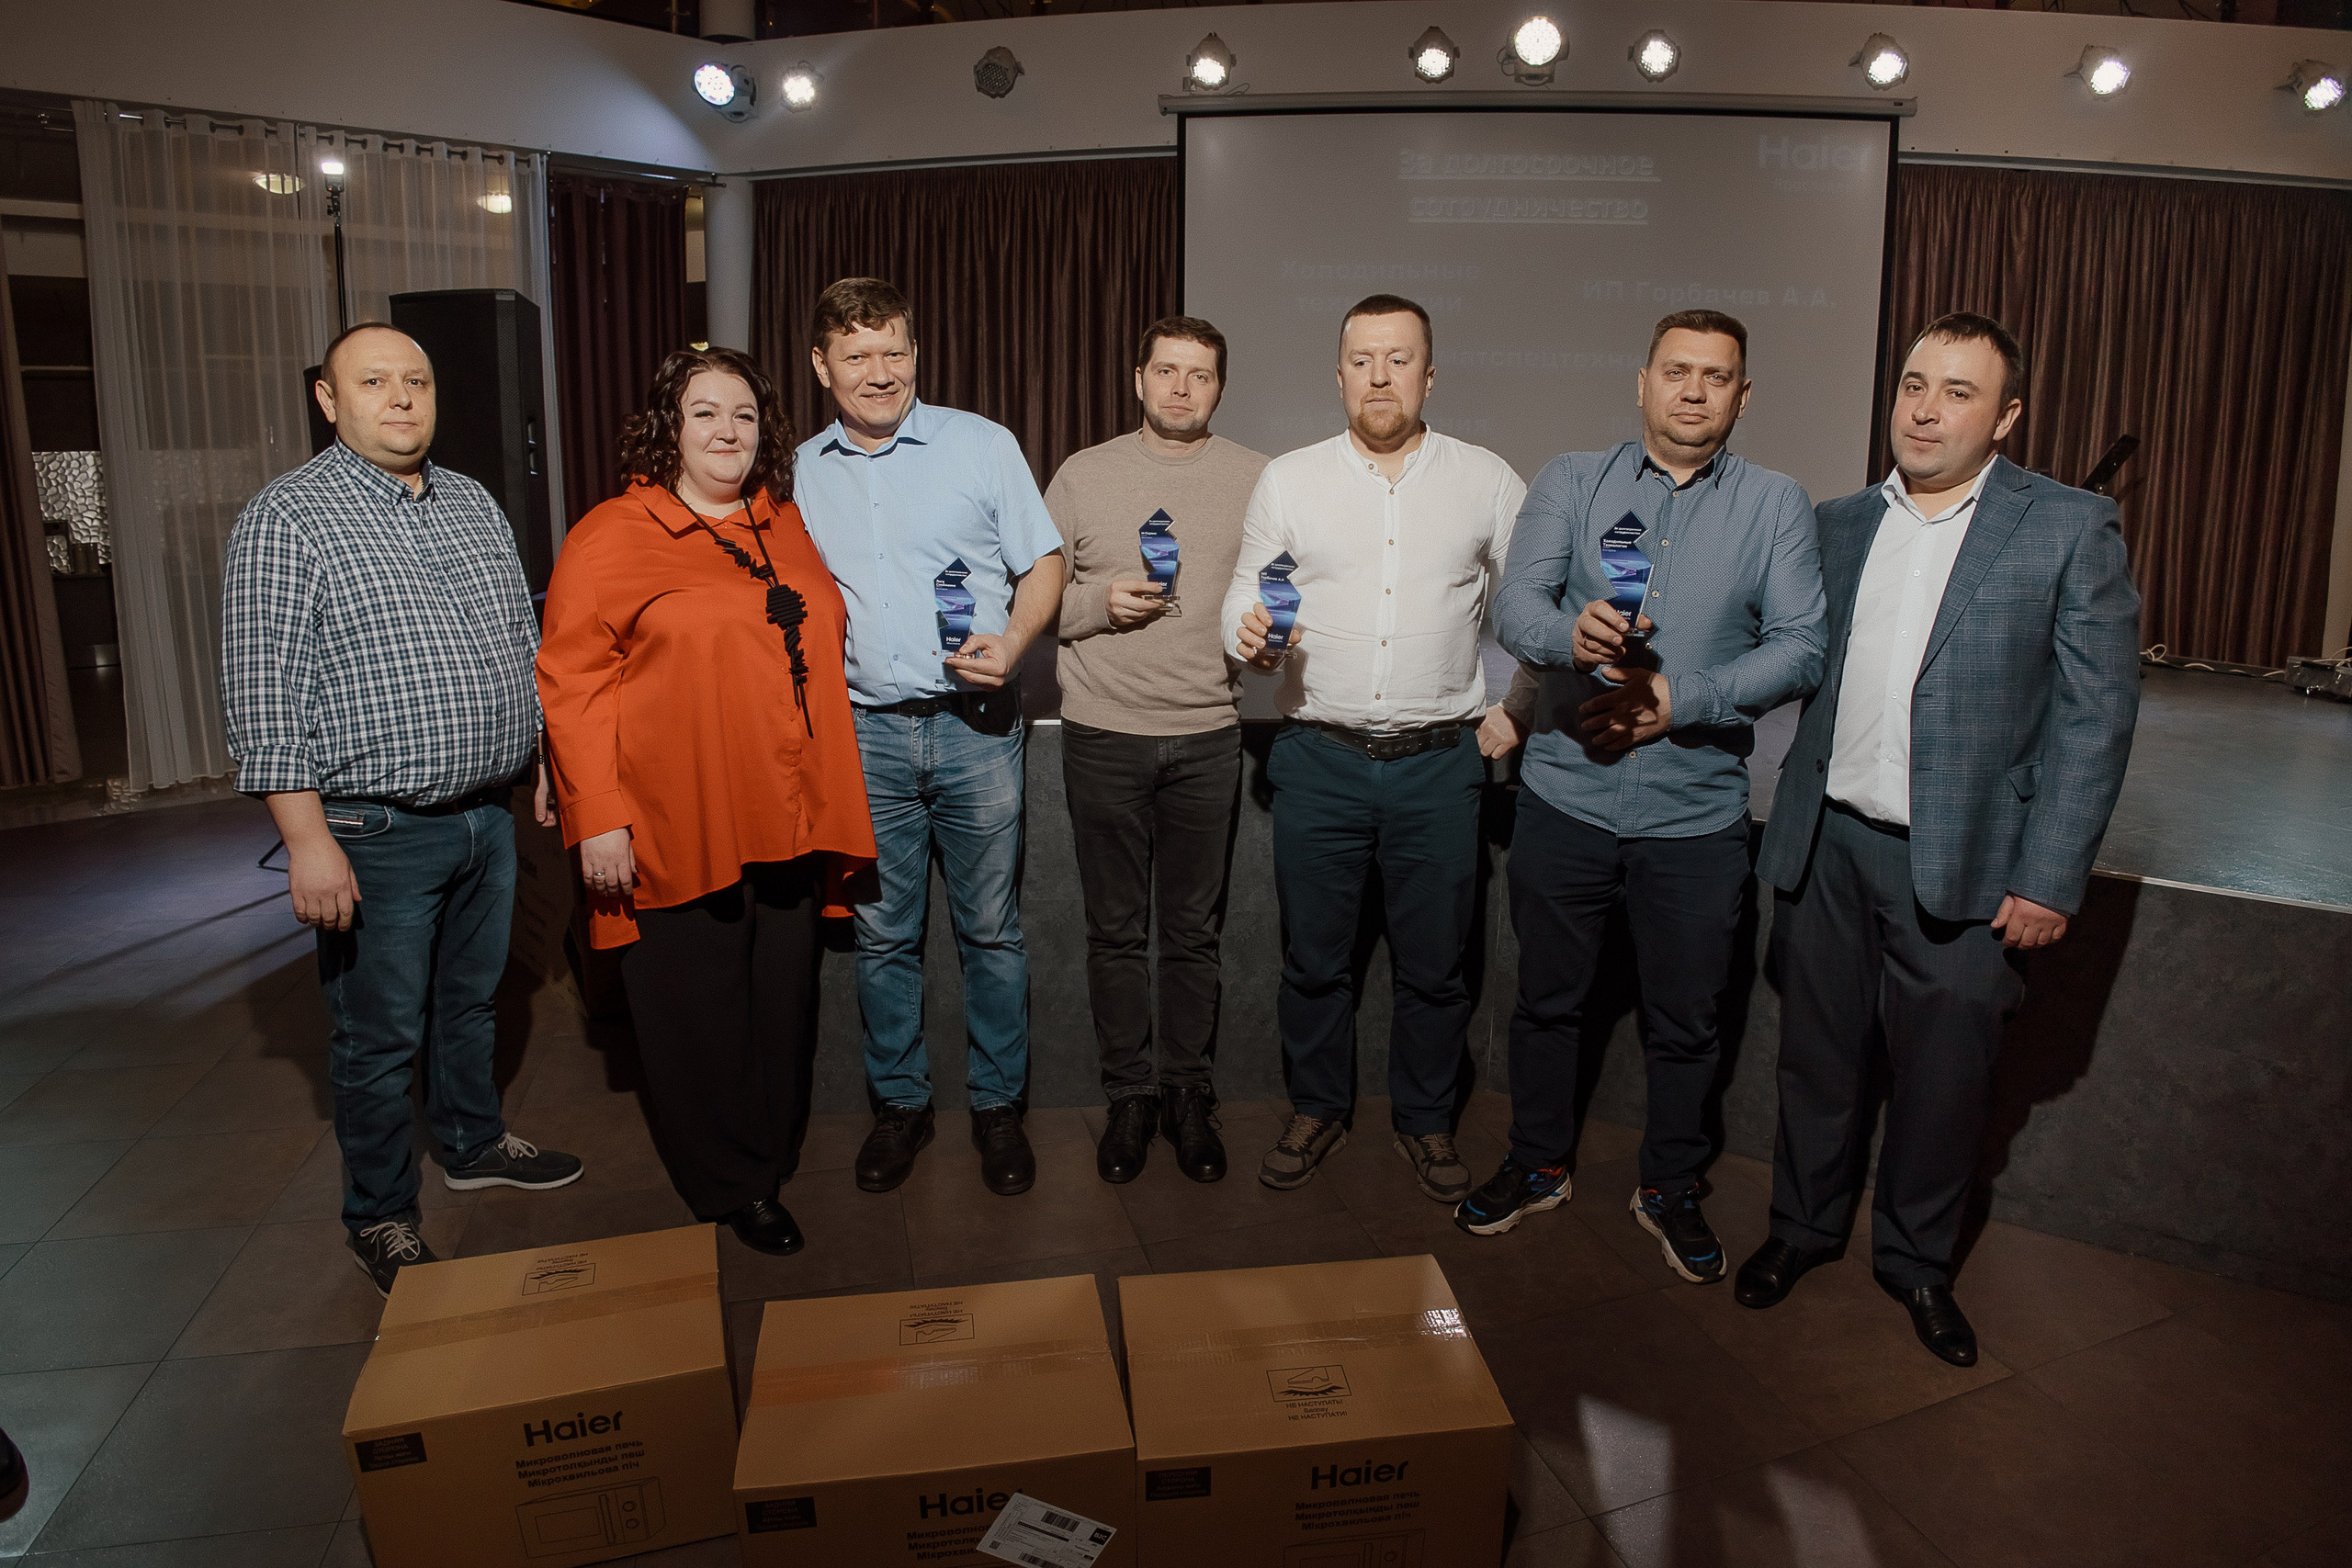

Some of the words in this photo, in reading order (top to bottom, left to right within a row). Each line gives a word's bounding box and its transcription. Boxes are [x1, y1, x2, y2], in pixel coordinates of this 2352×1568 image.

[1398, 148, 1434, 175] За
[1408, 196, 1650, 220] сотрудничество
[1636, 280, 1771, 307] Горбачев
[523, 1409, 624, 1448] Haier
[515, 1445, 612, 1469] Микроволновая
[615, 1439, 644, 1452] печь
[621, 1450, 645, 1461] пеш
[527, 1464, 619, 1488] Мікрохвильова
[621, 1460, 640, 1472] піч
[1310, 1459, 1409, 1491] Haier
[919, 1487, 1023, 1520] Haie
[1295, 1494, 1390, 1511] Микроволновая
[1393, 1491, 1421, 1500] печь
[1396, 1500, 1420, 1510] пеш
[1301, 1514, 1392, 1530] Мікрохвильова
[1395, 1511, 1411, 1520] піч
